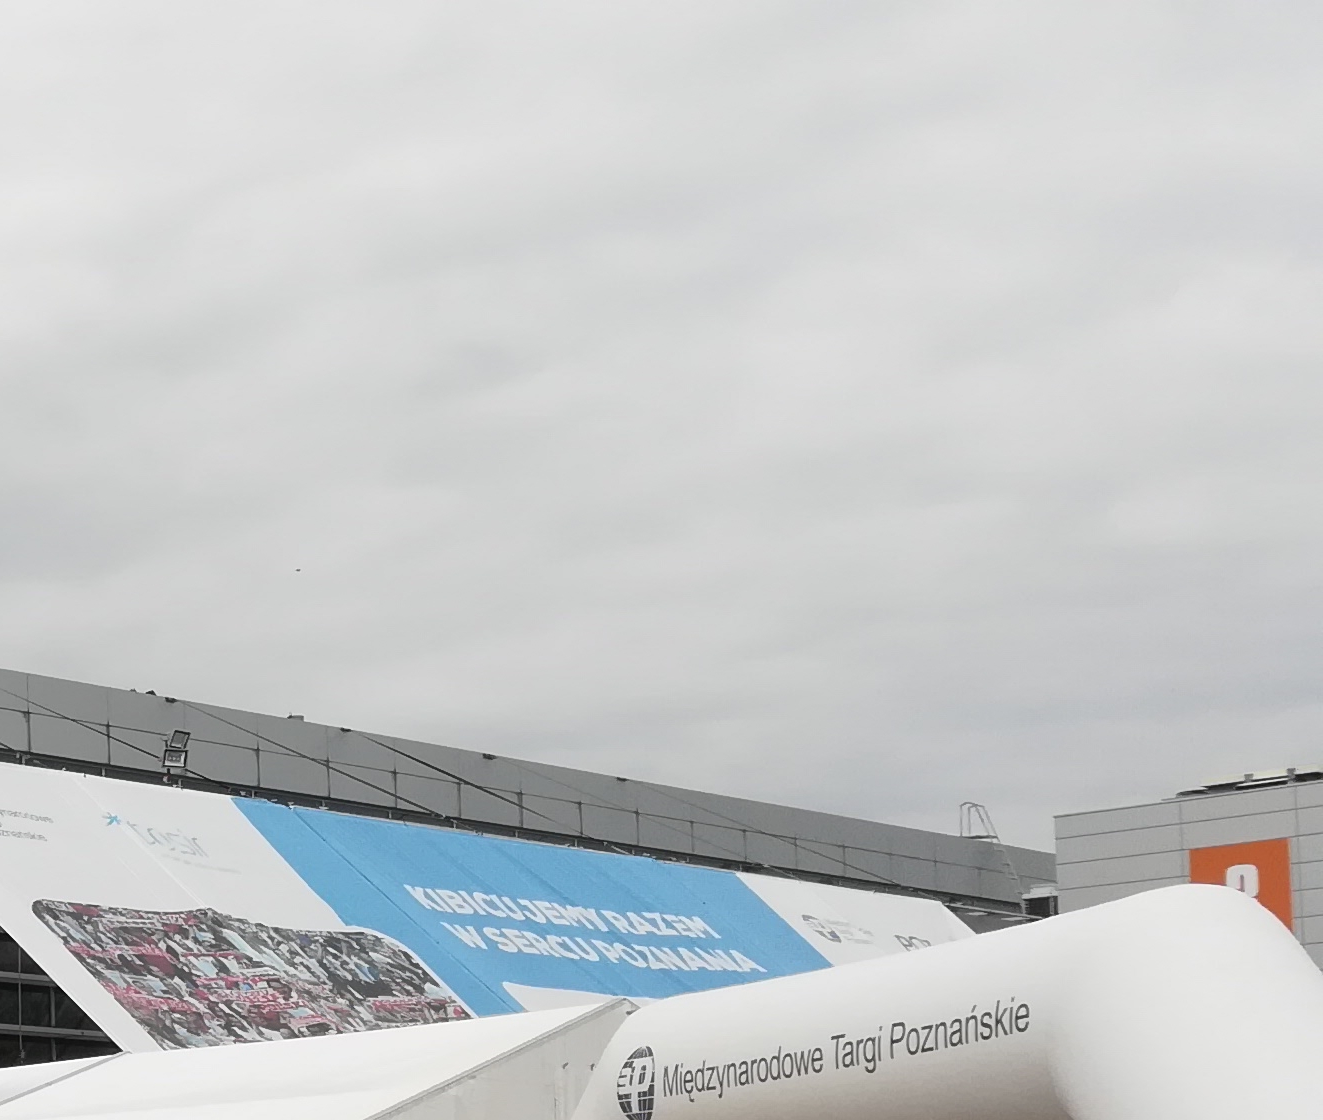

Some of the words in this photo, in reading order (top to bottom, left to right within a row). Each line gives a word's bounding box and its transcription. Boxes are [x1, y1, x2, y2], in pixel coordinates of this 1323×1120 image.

[404, 884, 608, 932] KIBICUJEMY
[604, 909, 722, 939] RAZEM
[440, 921, 488, 950] W
[484, 927, 601, 962] SERCU
[591, 938, 768, 972] POZNANIA
[662, 1045, 824, 1102] Międzynarodowe
[830, 1026, 884, 1073] Targi
[888, 996, 1031, 1059] Poznańskie
